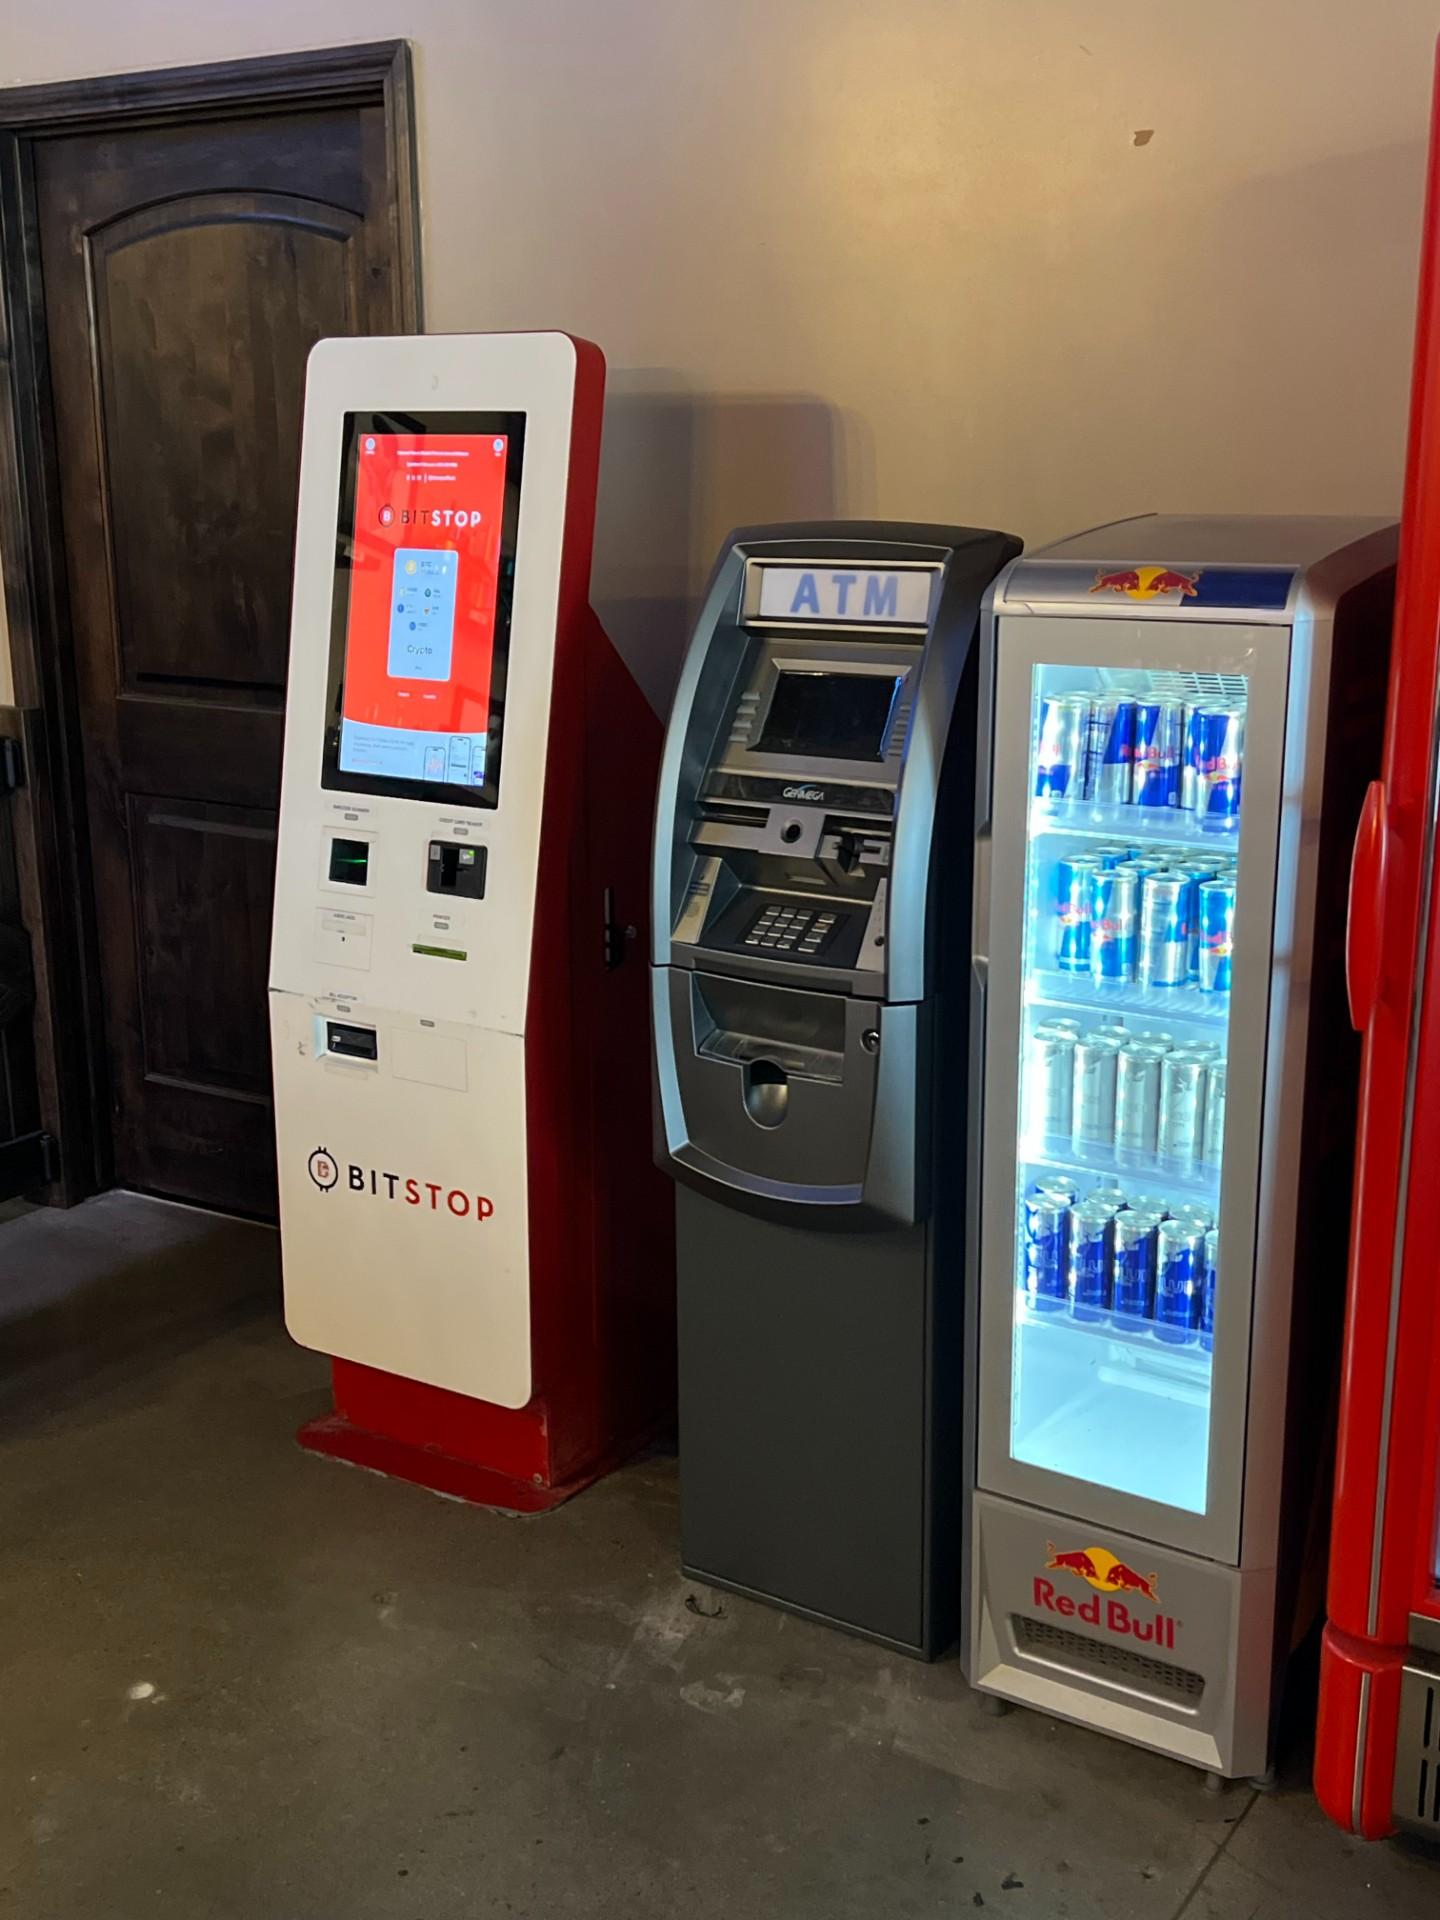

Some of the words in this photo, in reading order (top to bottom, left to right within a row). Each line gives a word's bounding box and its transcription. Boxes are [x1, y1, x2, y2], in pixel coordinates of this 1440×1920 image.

[400, 509, 482, 528] BITSTOP
[789, 572, 899, 618] ATM
[407, 644, 433, 656] Crypto
[348, 1164, 494, 1222] BITSTOP
[1033, 1576, 1101, 1626] Red
[1107, 1599, 1175, 1650] Bull
